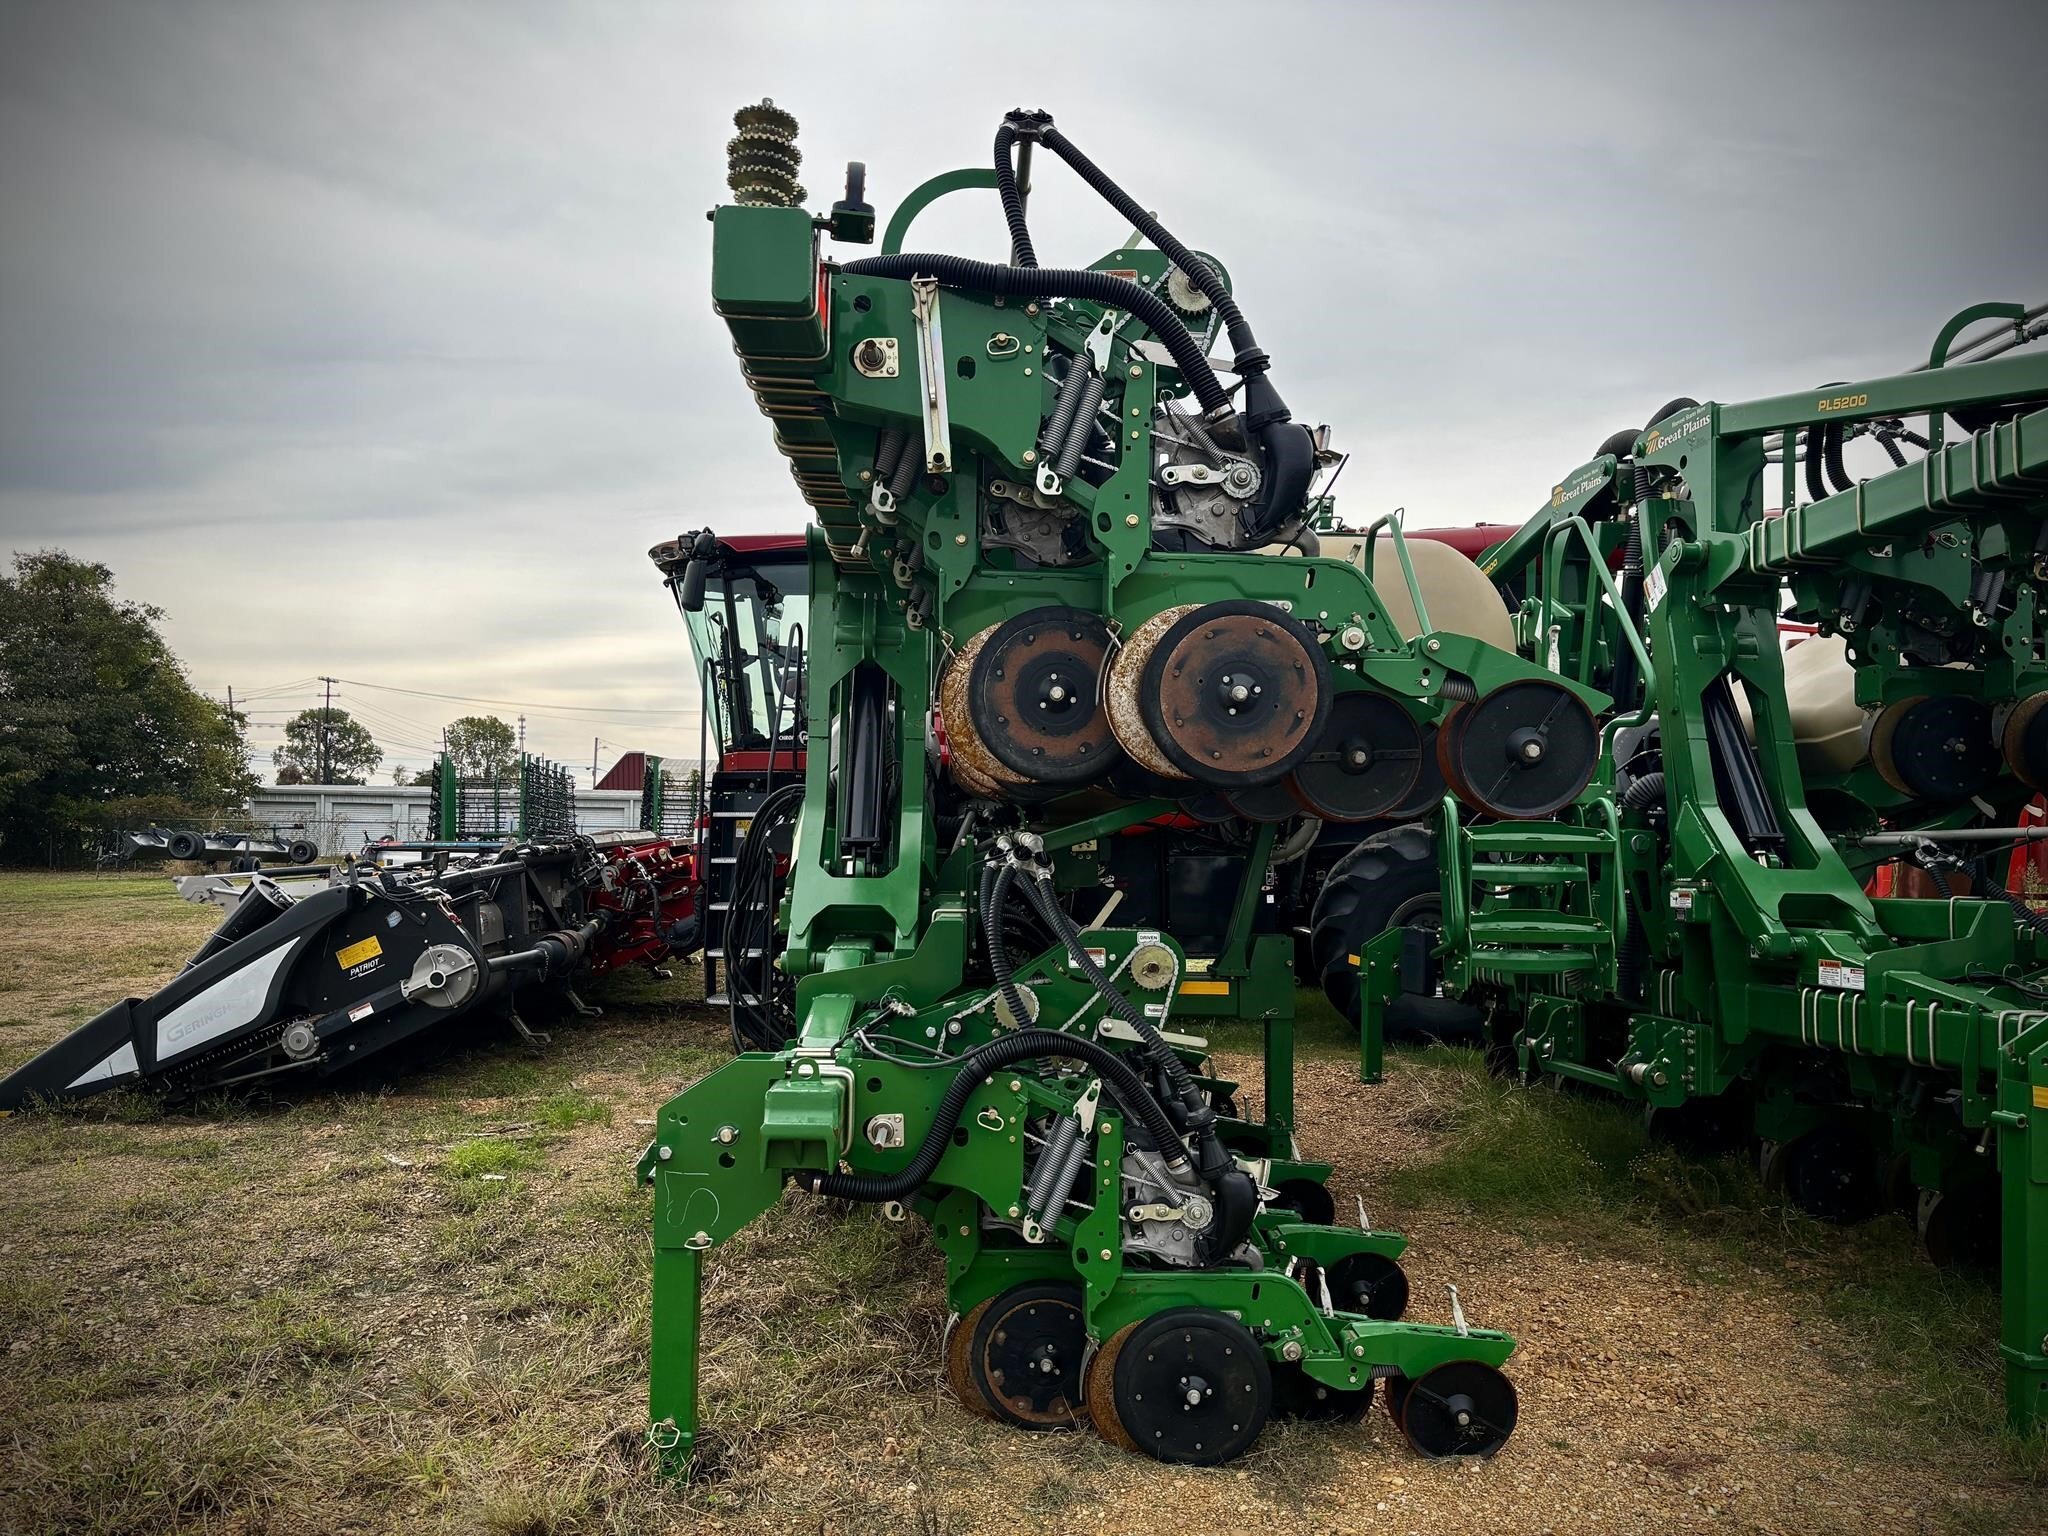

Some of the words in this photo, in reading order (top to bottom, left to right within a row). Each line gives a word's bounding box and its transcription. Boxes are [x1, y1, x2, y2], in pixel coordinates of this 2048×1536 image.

[1817, 394, 1867, 412] PL5200
[1657, 426, 1683, 449] Great
[1682, 414, 1712, 437] Plains
[1561, 485, 1581, 503] Great
[1580, 475, 1602, 494] Plains
[349, 957, 381, 977] PATRIOT
